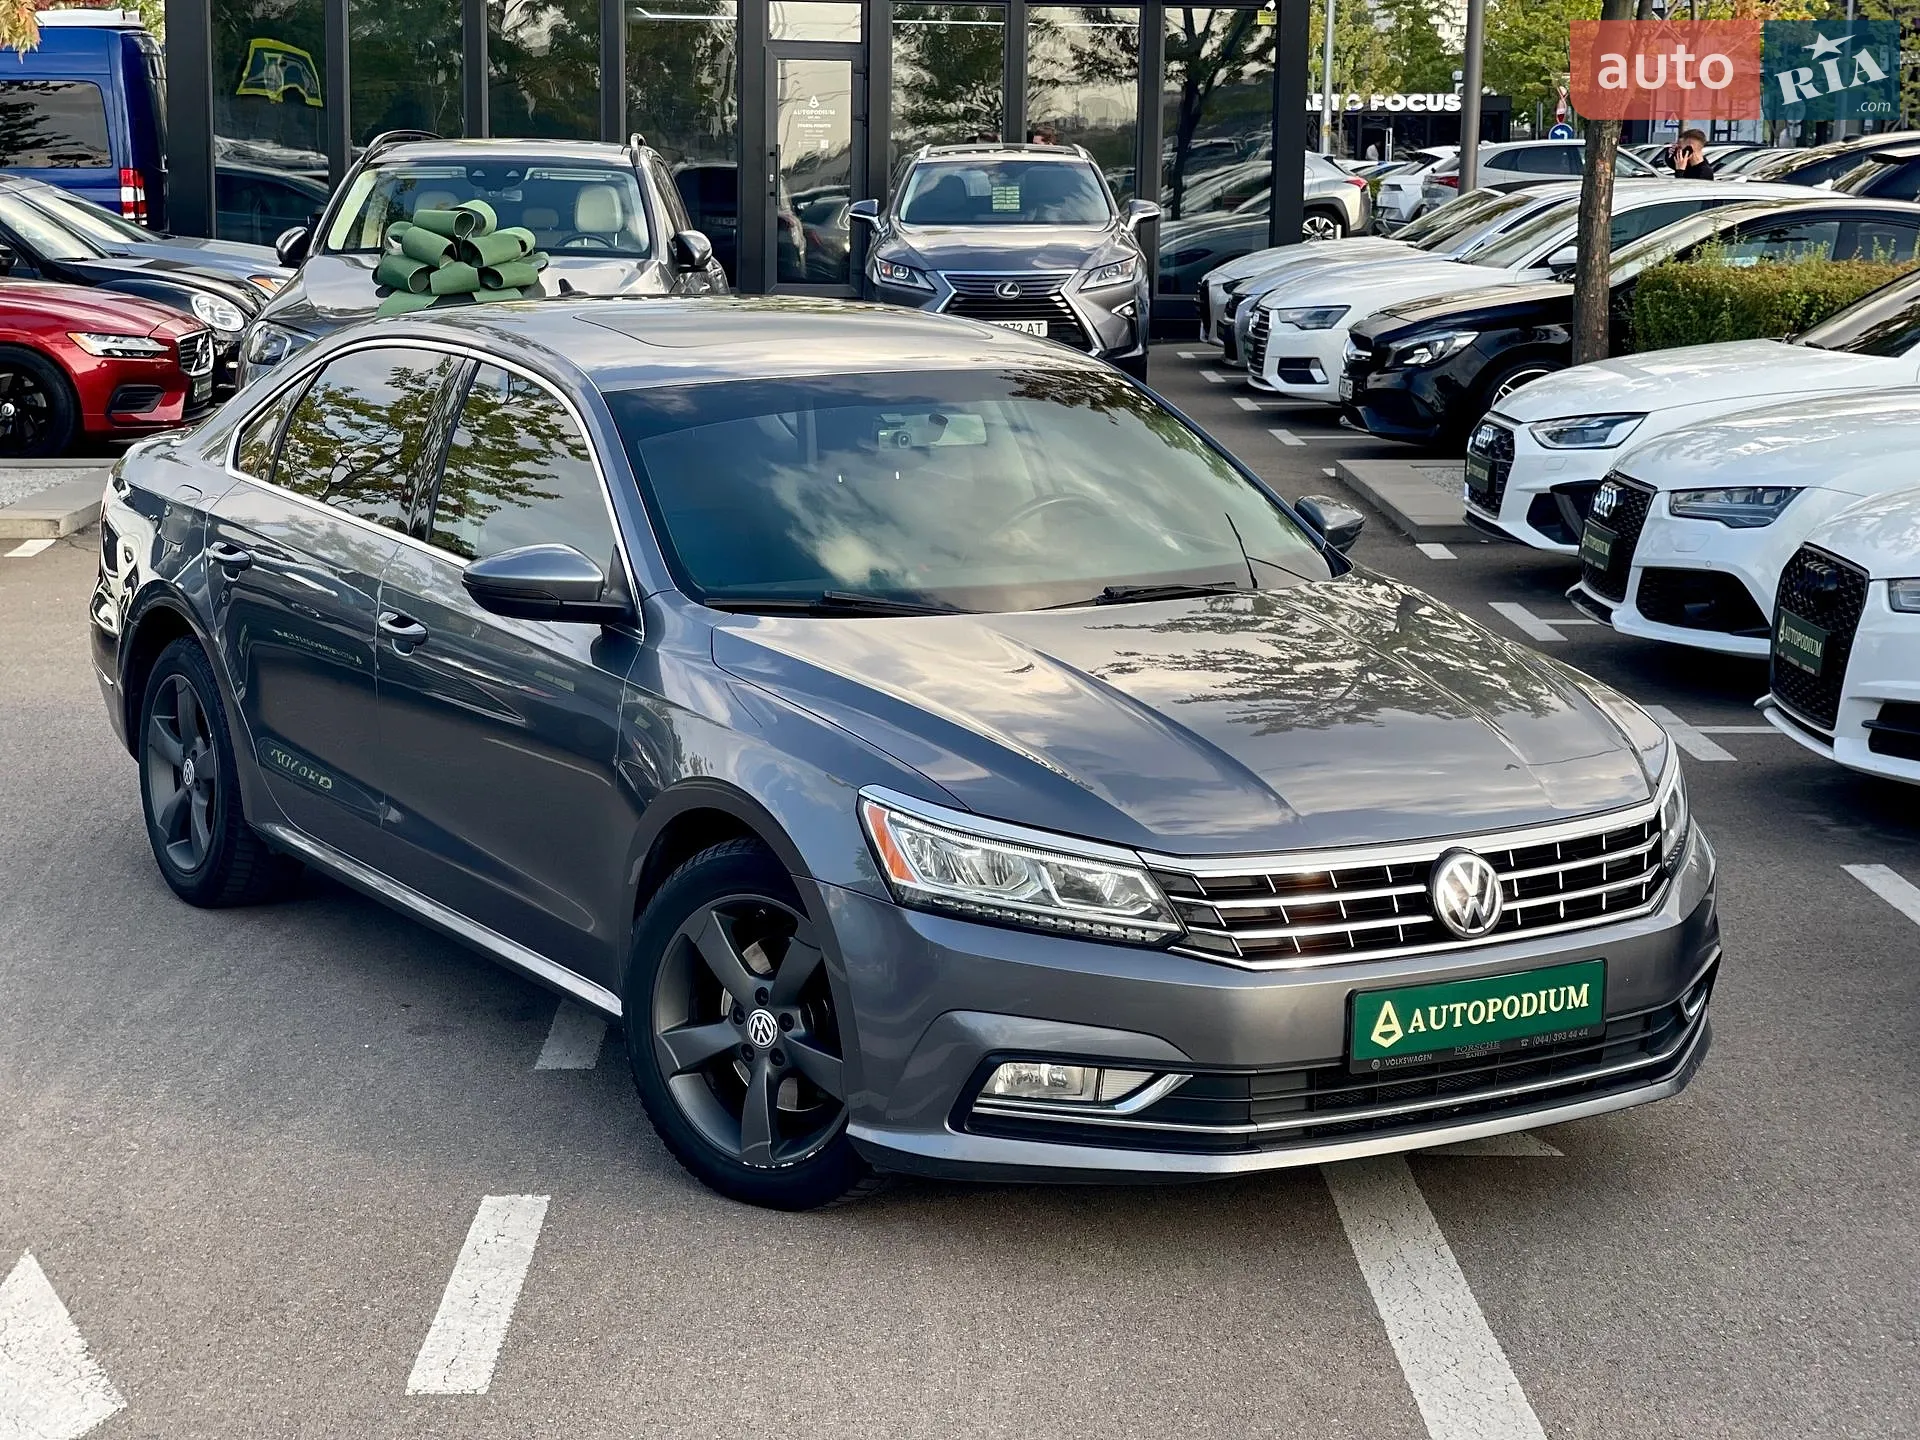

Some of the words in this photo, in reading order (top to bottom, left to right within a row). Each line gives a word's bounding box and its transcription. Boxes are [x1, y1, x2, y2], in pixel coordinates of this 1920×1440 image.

[1371, 94, 1461, 112] FOCUS
[1027, 323, 1044, 335] AT
[1408, 983, 1590, 1034] AUTOPODIUM
[1532, 1035, 1552, 1046] (044)
[1552, 1032, 1567, 1042] 393
[1568, 1030, 1577, 1039] 44
[1578, 1028, 1588, 1037] 44
[1385, 1053, 1433, 1067] VOLKSWAGEN
